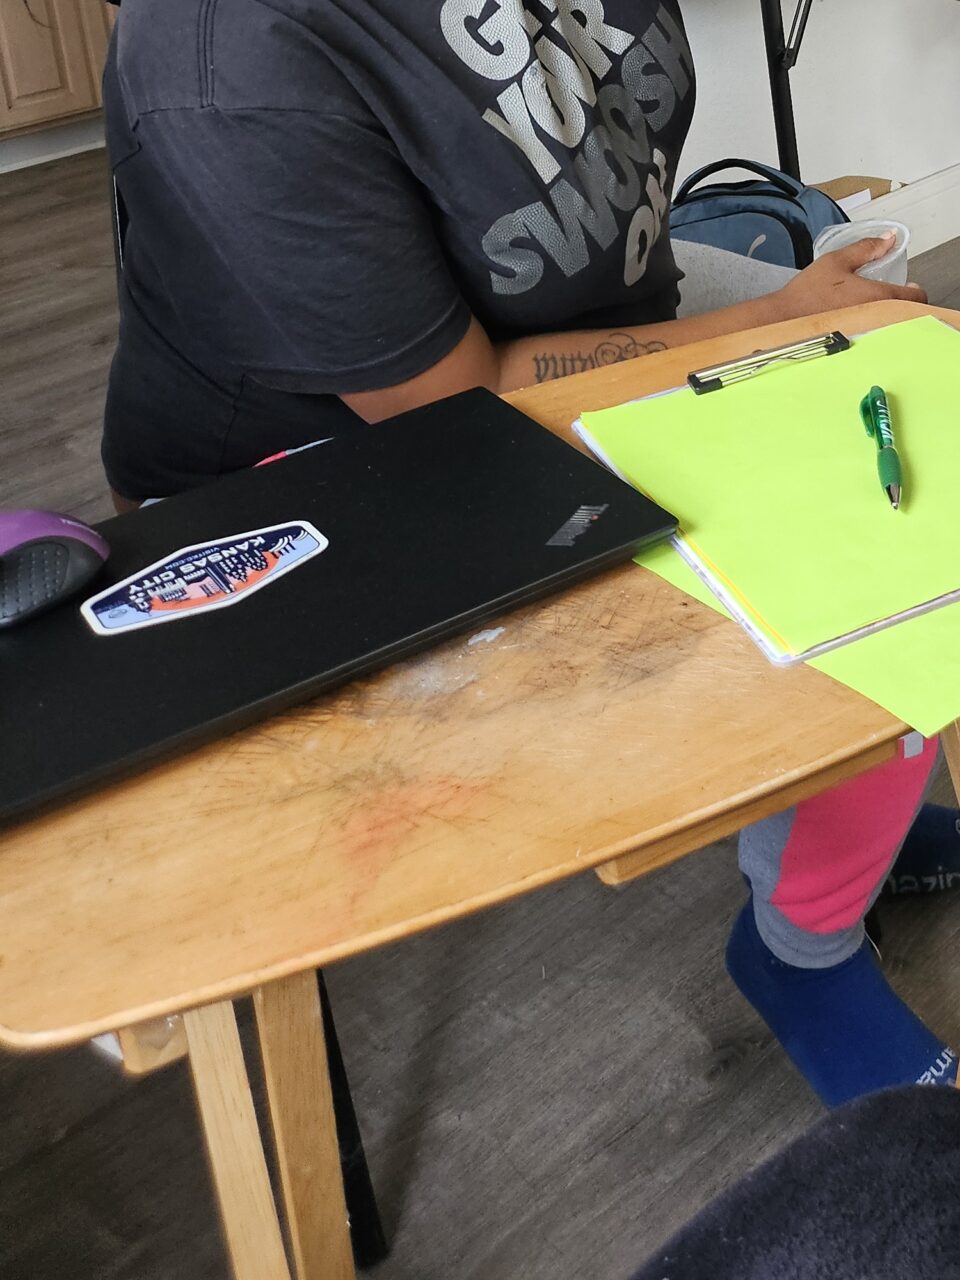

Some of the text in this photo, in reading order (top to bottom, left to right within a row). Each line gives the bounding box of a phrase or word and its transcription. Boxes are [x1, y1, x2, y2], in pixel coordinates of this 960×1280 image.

[481, 3, 690, 296] SWOOSH
[127, 536, 266, 594] KANSAS CITY
